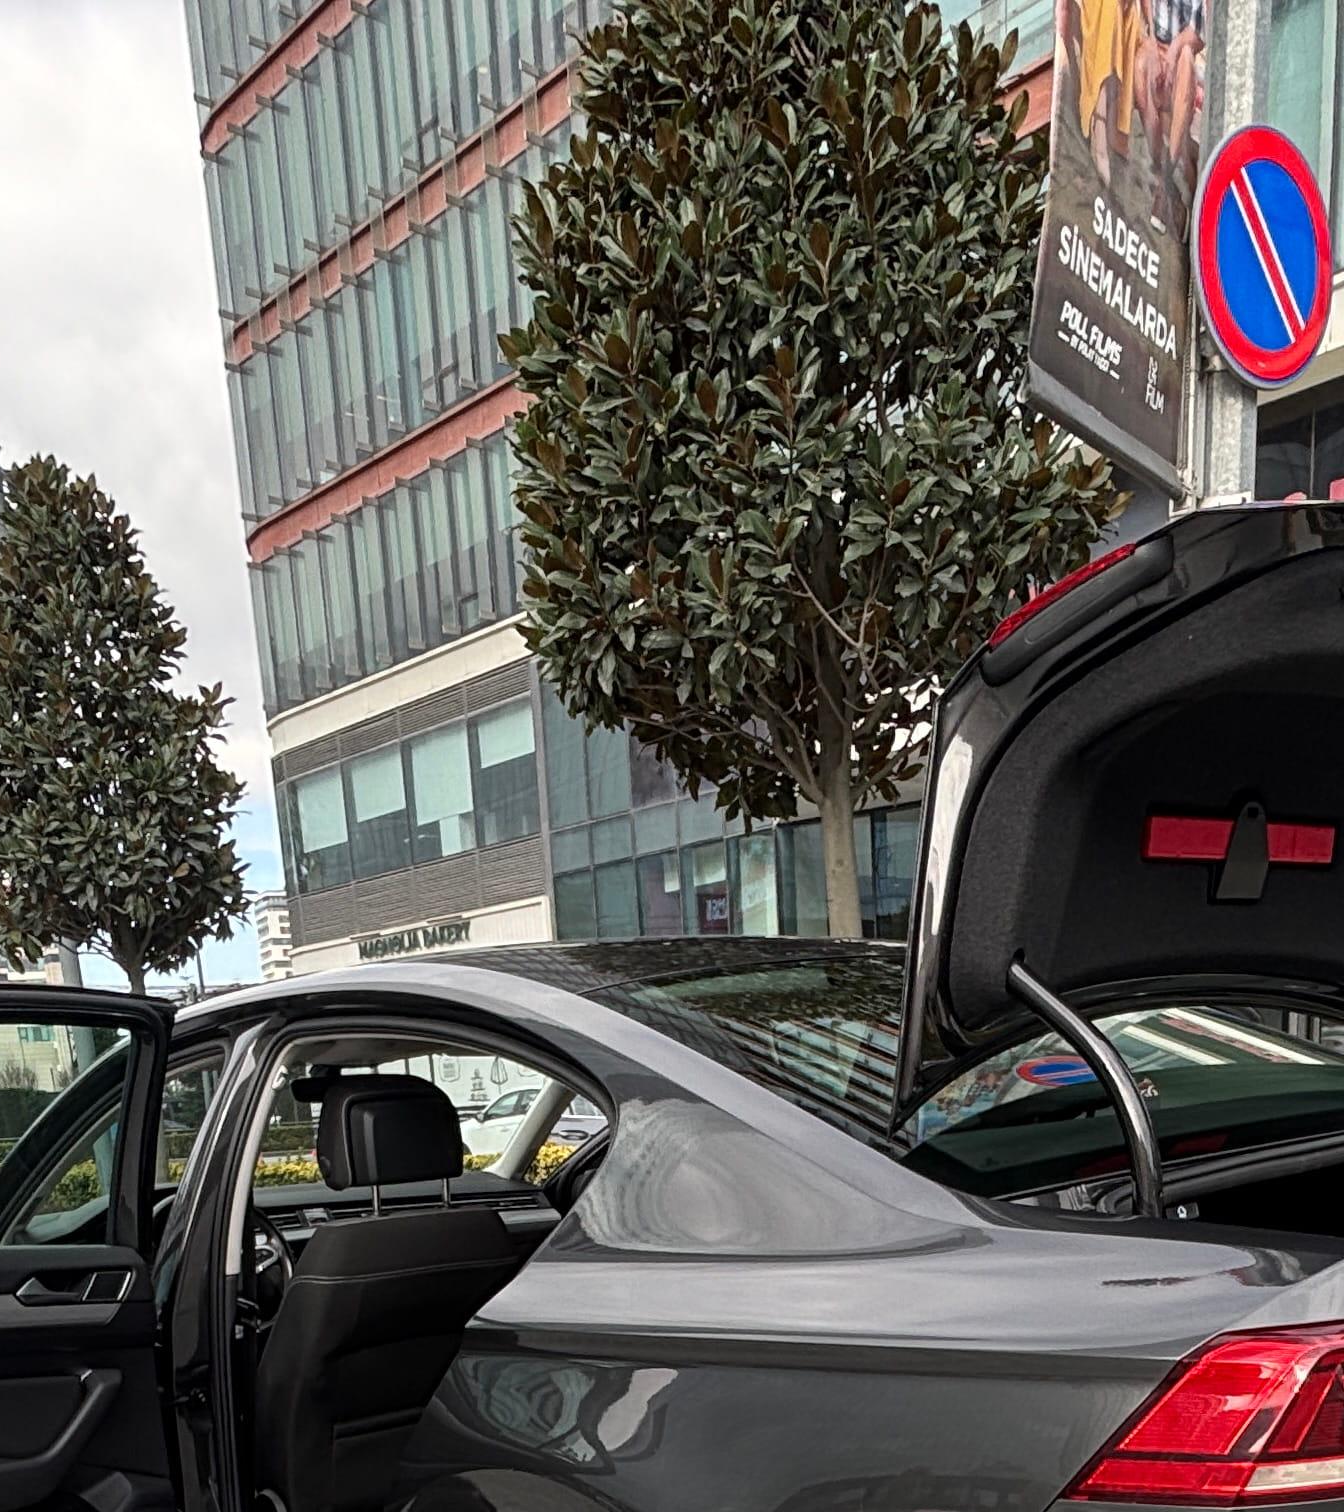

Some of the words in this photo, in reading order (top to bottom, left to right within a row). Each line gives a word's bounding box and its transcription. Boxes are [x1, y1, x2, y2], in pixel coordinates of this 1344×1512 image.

[1092, 195, 1160, 289] SADECE
[1057, 222, 1177, 361] SİNEMALARDA
[1060, 299, 1089, 341] POLL
